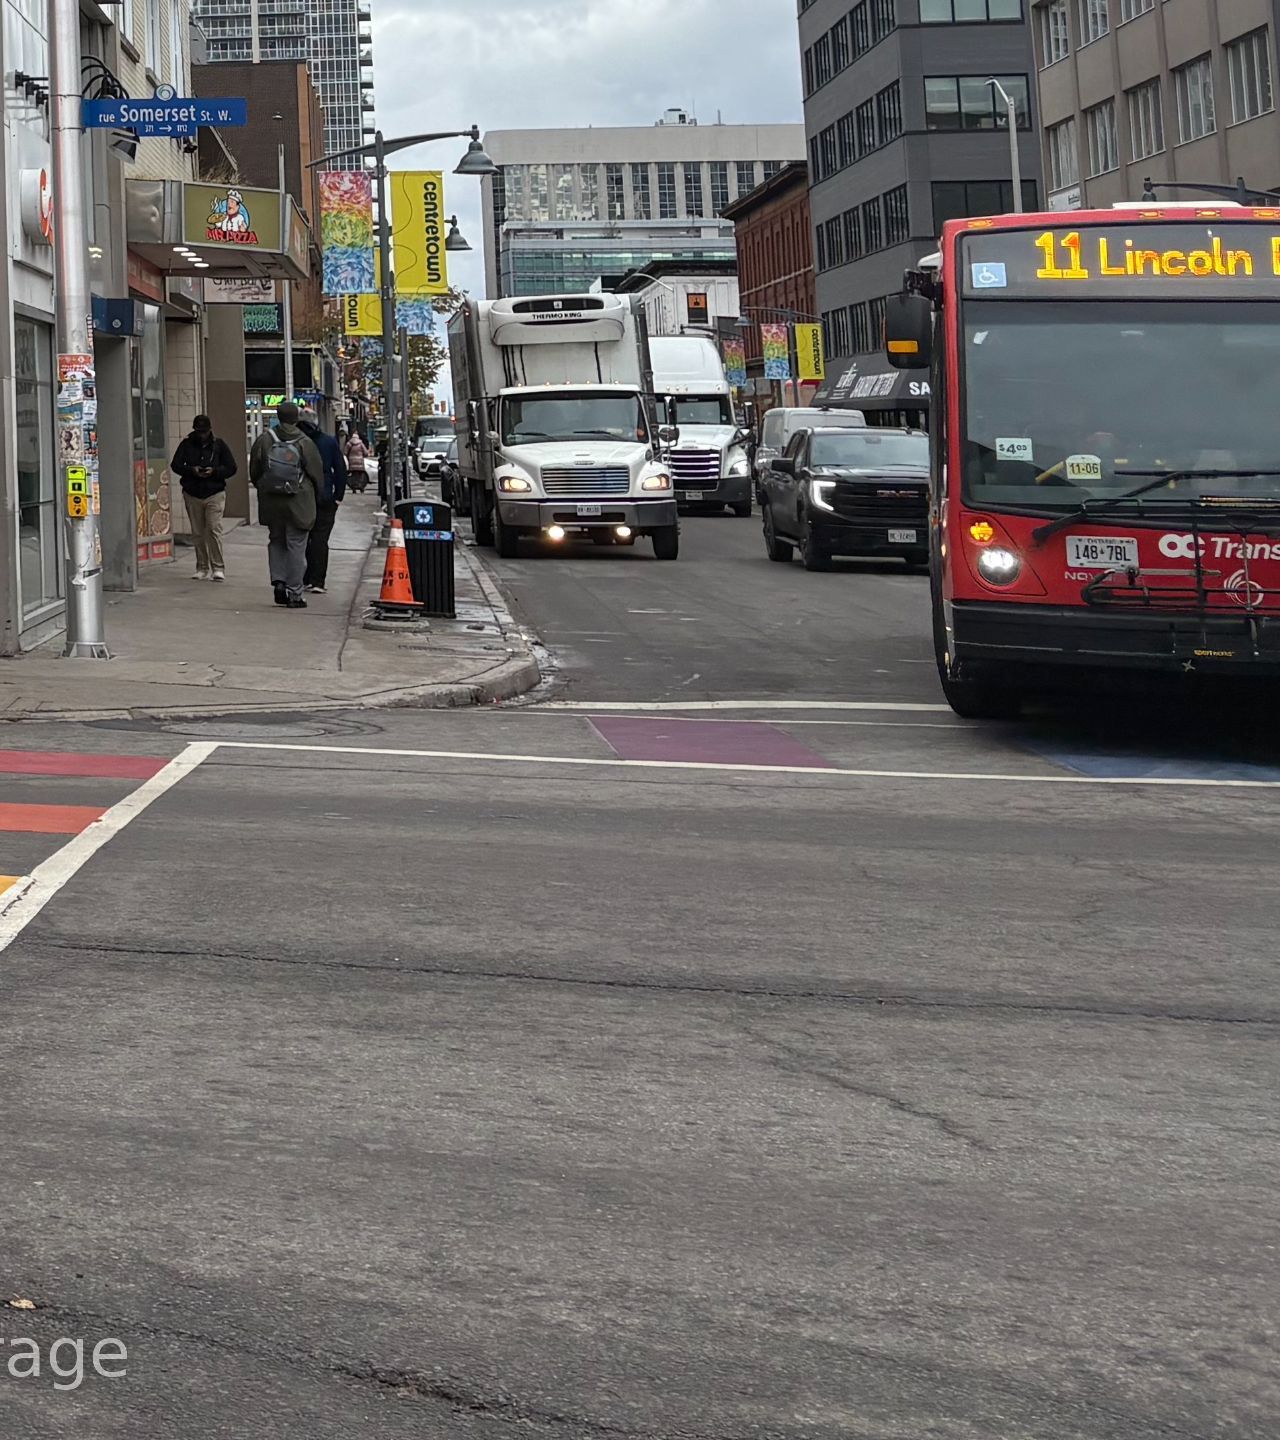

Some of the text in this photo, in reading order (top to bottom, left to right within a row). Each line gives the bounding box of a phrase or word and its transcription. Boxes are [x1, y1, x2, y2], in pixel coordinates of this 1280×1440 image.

[98, 104, 232, 123] rue Somerset St. W.
[423, 181, 443, 284] centretown
[1034, 231, 1089, 279] 11
[1099, 236, 1253, 276] Lincoln
[532, 312, 563, 320] THERMO
[1074, 543, 1099, 560] 148
[1158, 533, 1206, 559] OC
